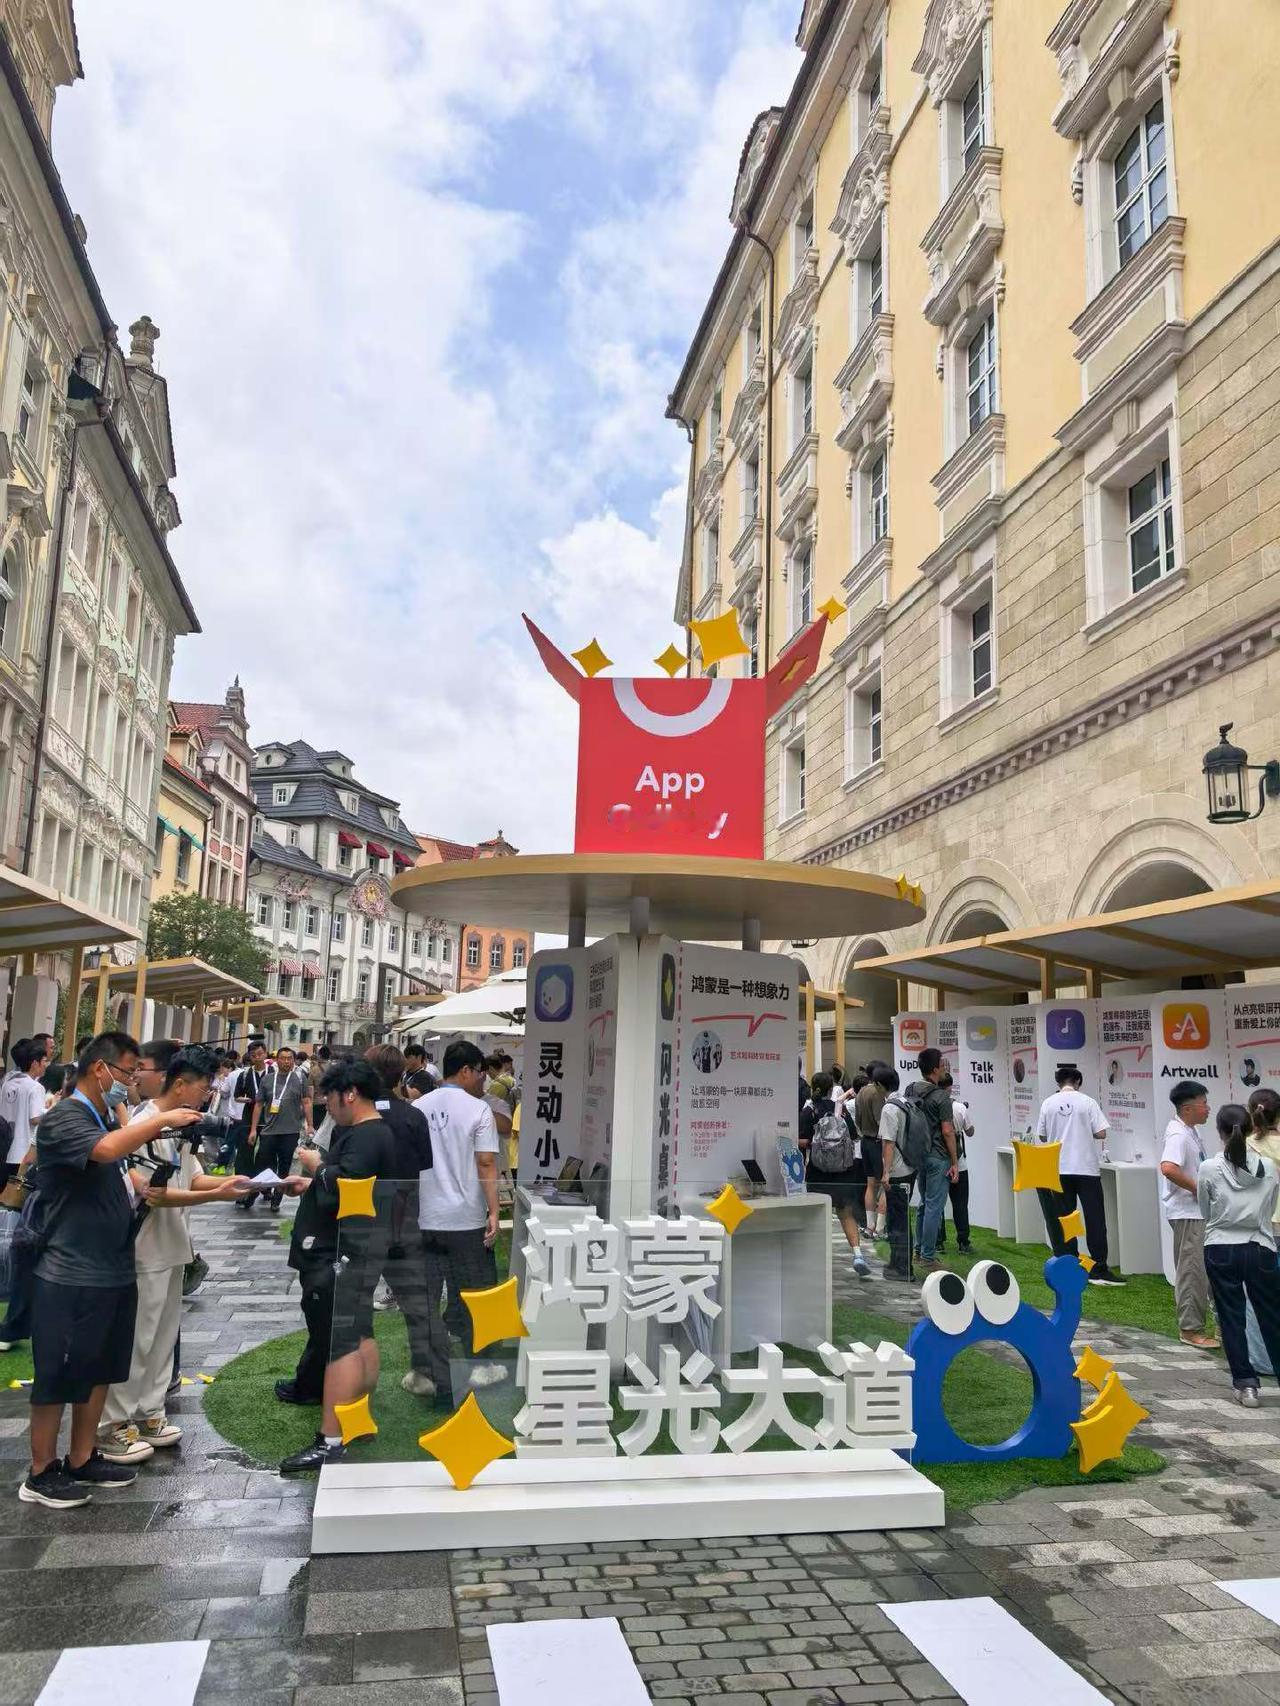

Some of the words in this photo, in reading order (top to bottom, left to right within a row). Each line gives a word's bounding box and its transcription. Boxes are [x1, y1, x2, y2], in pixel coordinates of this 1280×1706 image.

[634, 765, 705, 799] App
[691, 975, 790, 1000] 鸿蒙是一种想象力
[970, 1061, 994, 1072] Talk
[970, 1073, 994, 1084] Talk
[1161, 1064, 1219, 1078] Artwall
[520, 1214, 727, 1324] 鸿蒙
[512, 1340, 918, 1459] 星光大道
